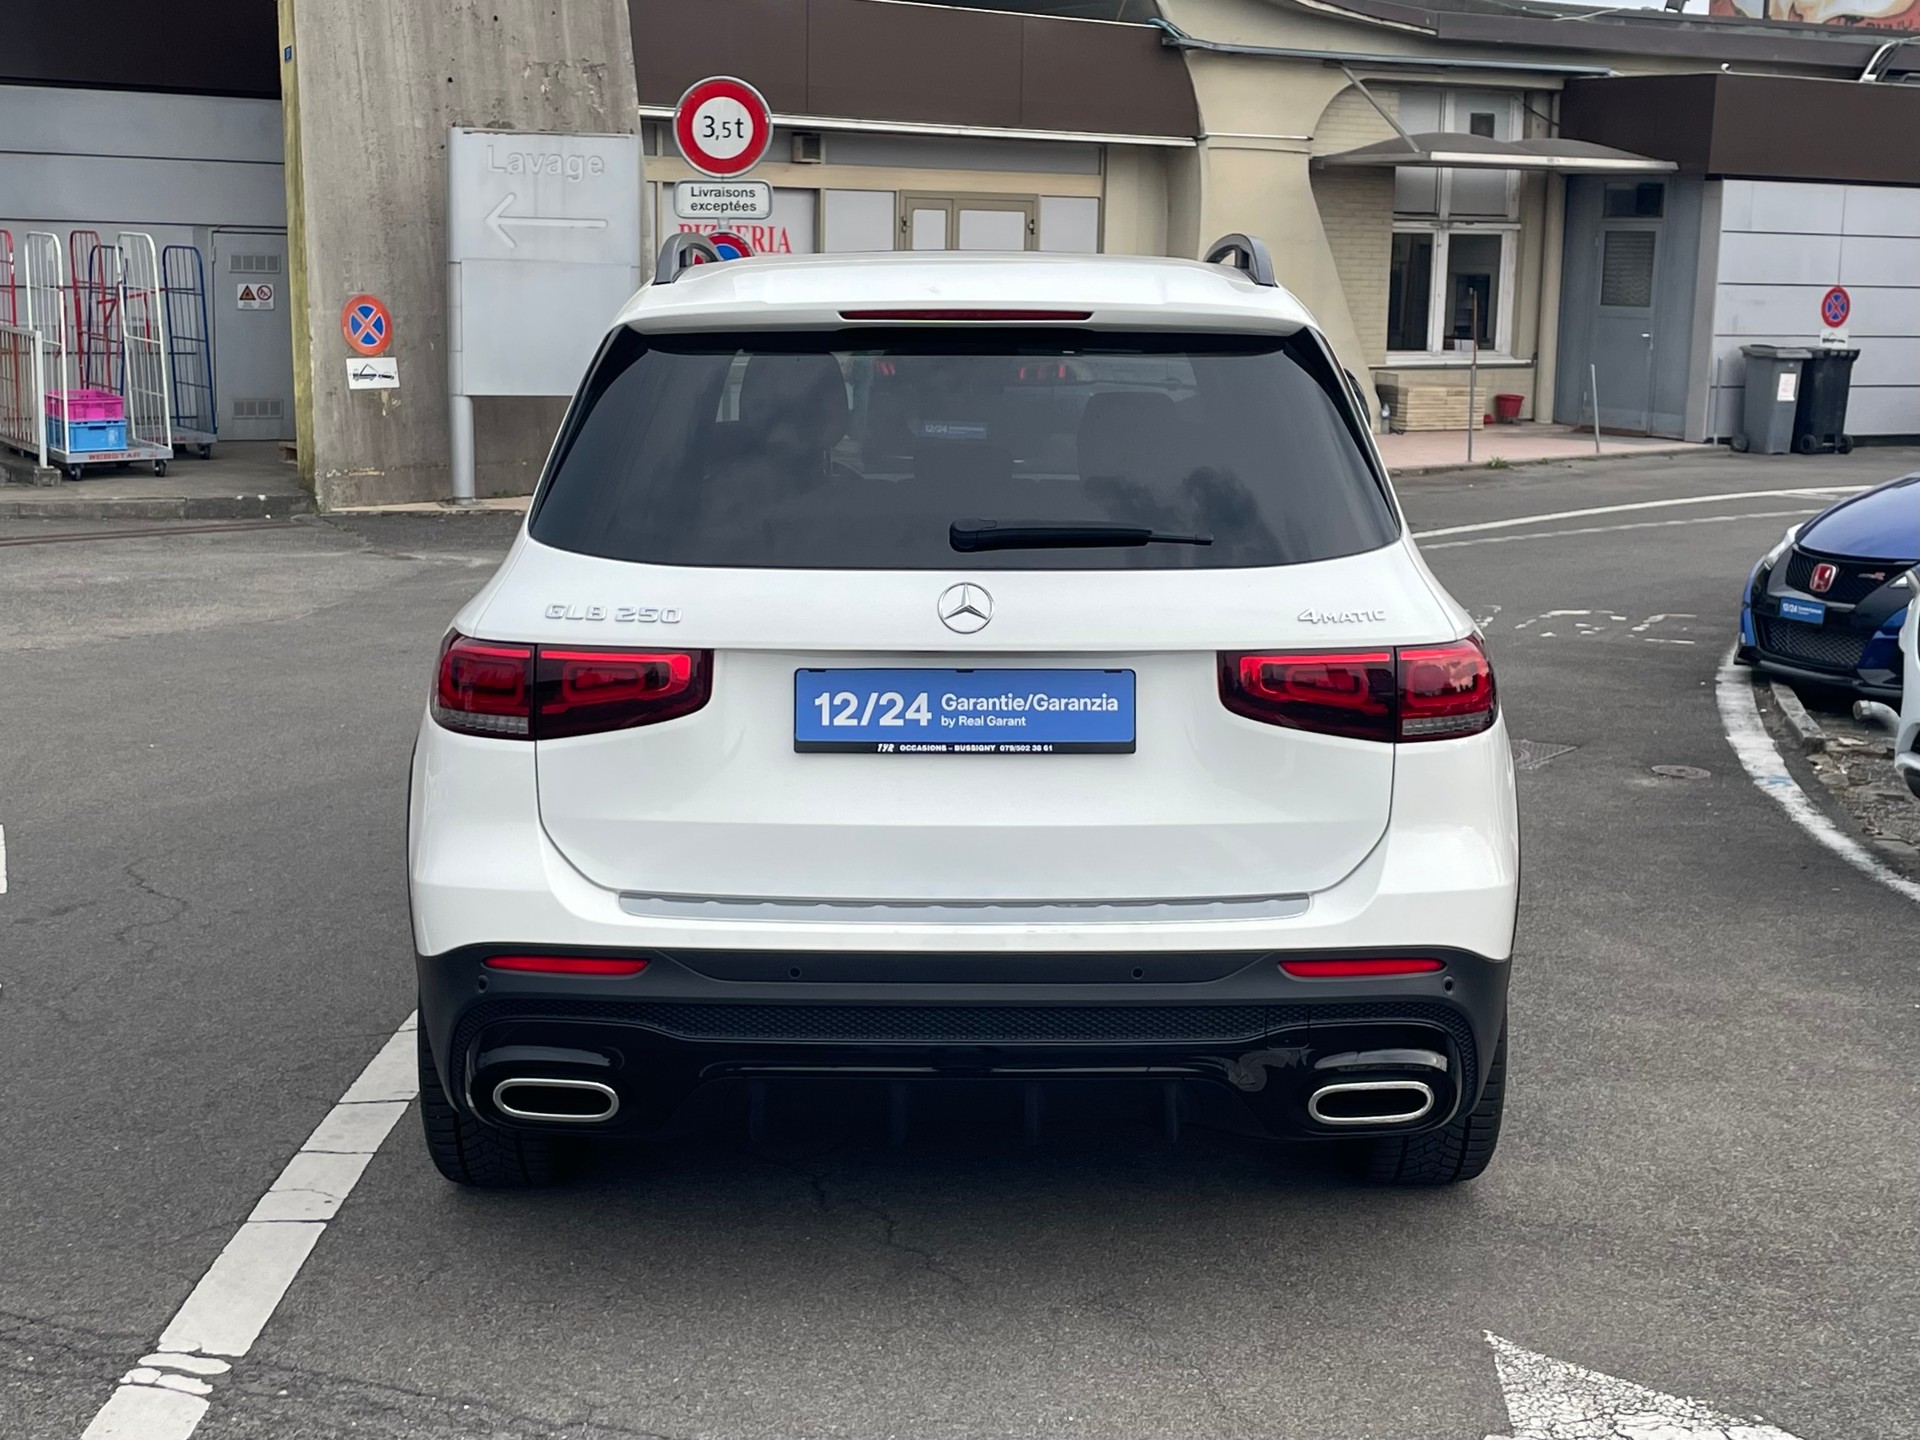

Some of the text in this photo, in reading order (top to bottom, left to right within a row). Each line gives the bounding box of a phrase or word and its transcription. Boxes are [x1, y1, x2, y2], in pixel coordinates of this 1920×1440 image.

[486, 144, 605, 182] Lavage
[690, 186, 756, 198] Livraisons
[690, 200, 757, 213] exceptées
[545, 603, 683, 624] GLB 250
[1297, 608, 1386, 625] 4MATIC
[814, 691, 1119, 727] 12/24 Garantie/Garanzia
[941, 715, 1027, 728] by Real Garant
[899, 744, 947, 752] OCCASIONS
[954, 744, 996, 752] BUSSIGNY
